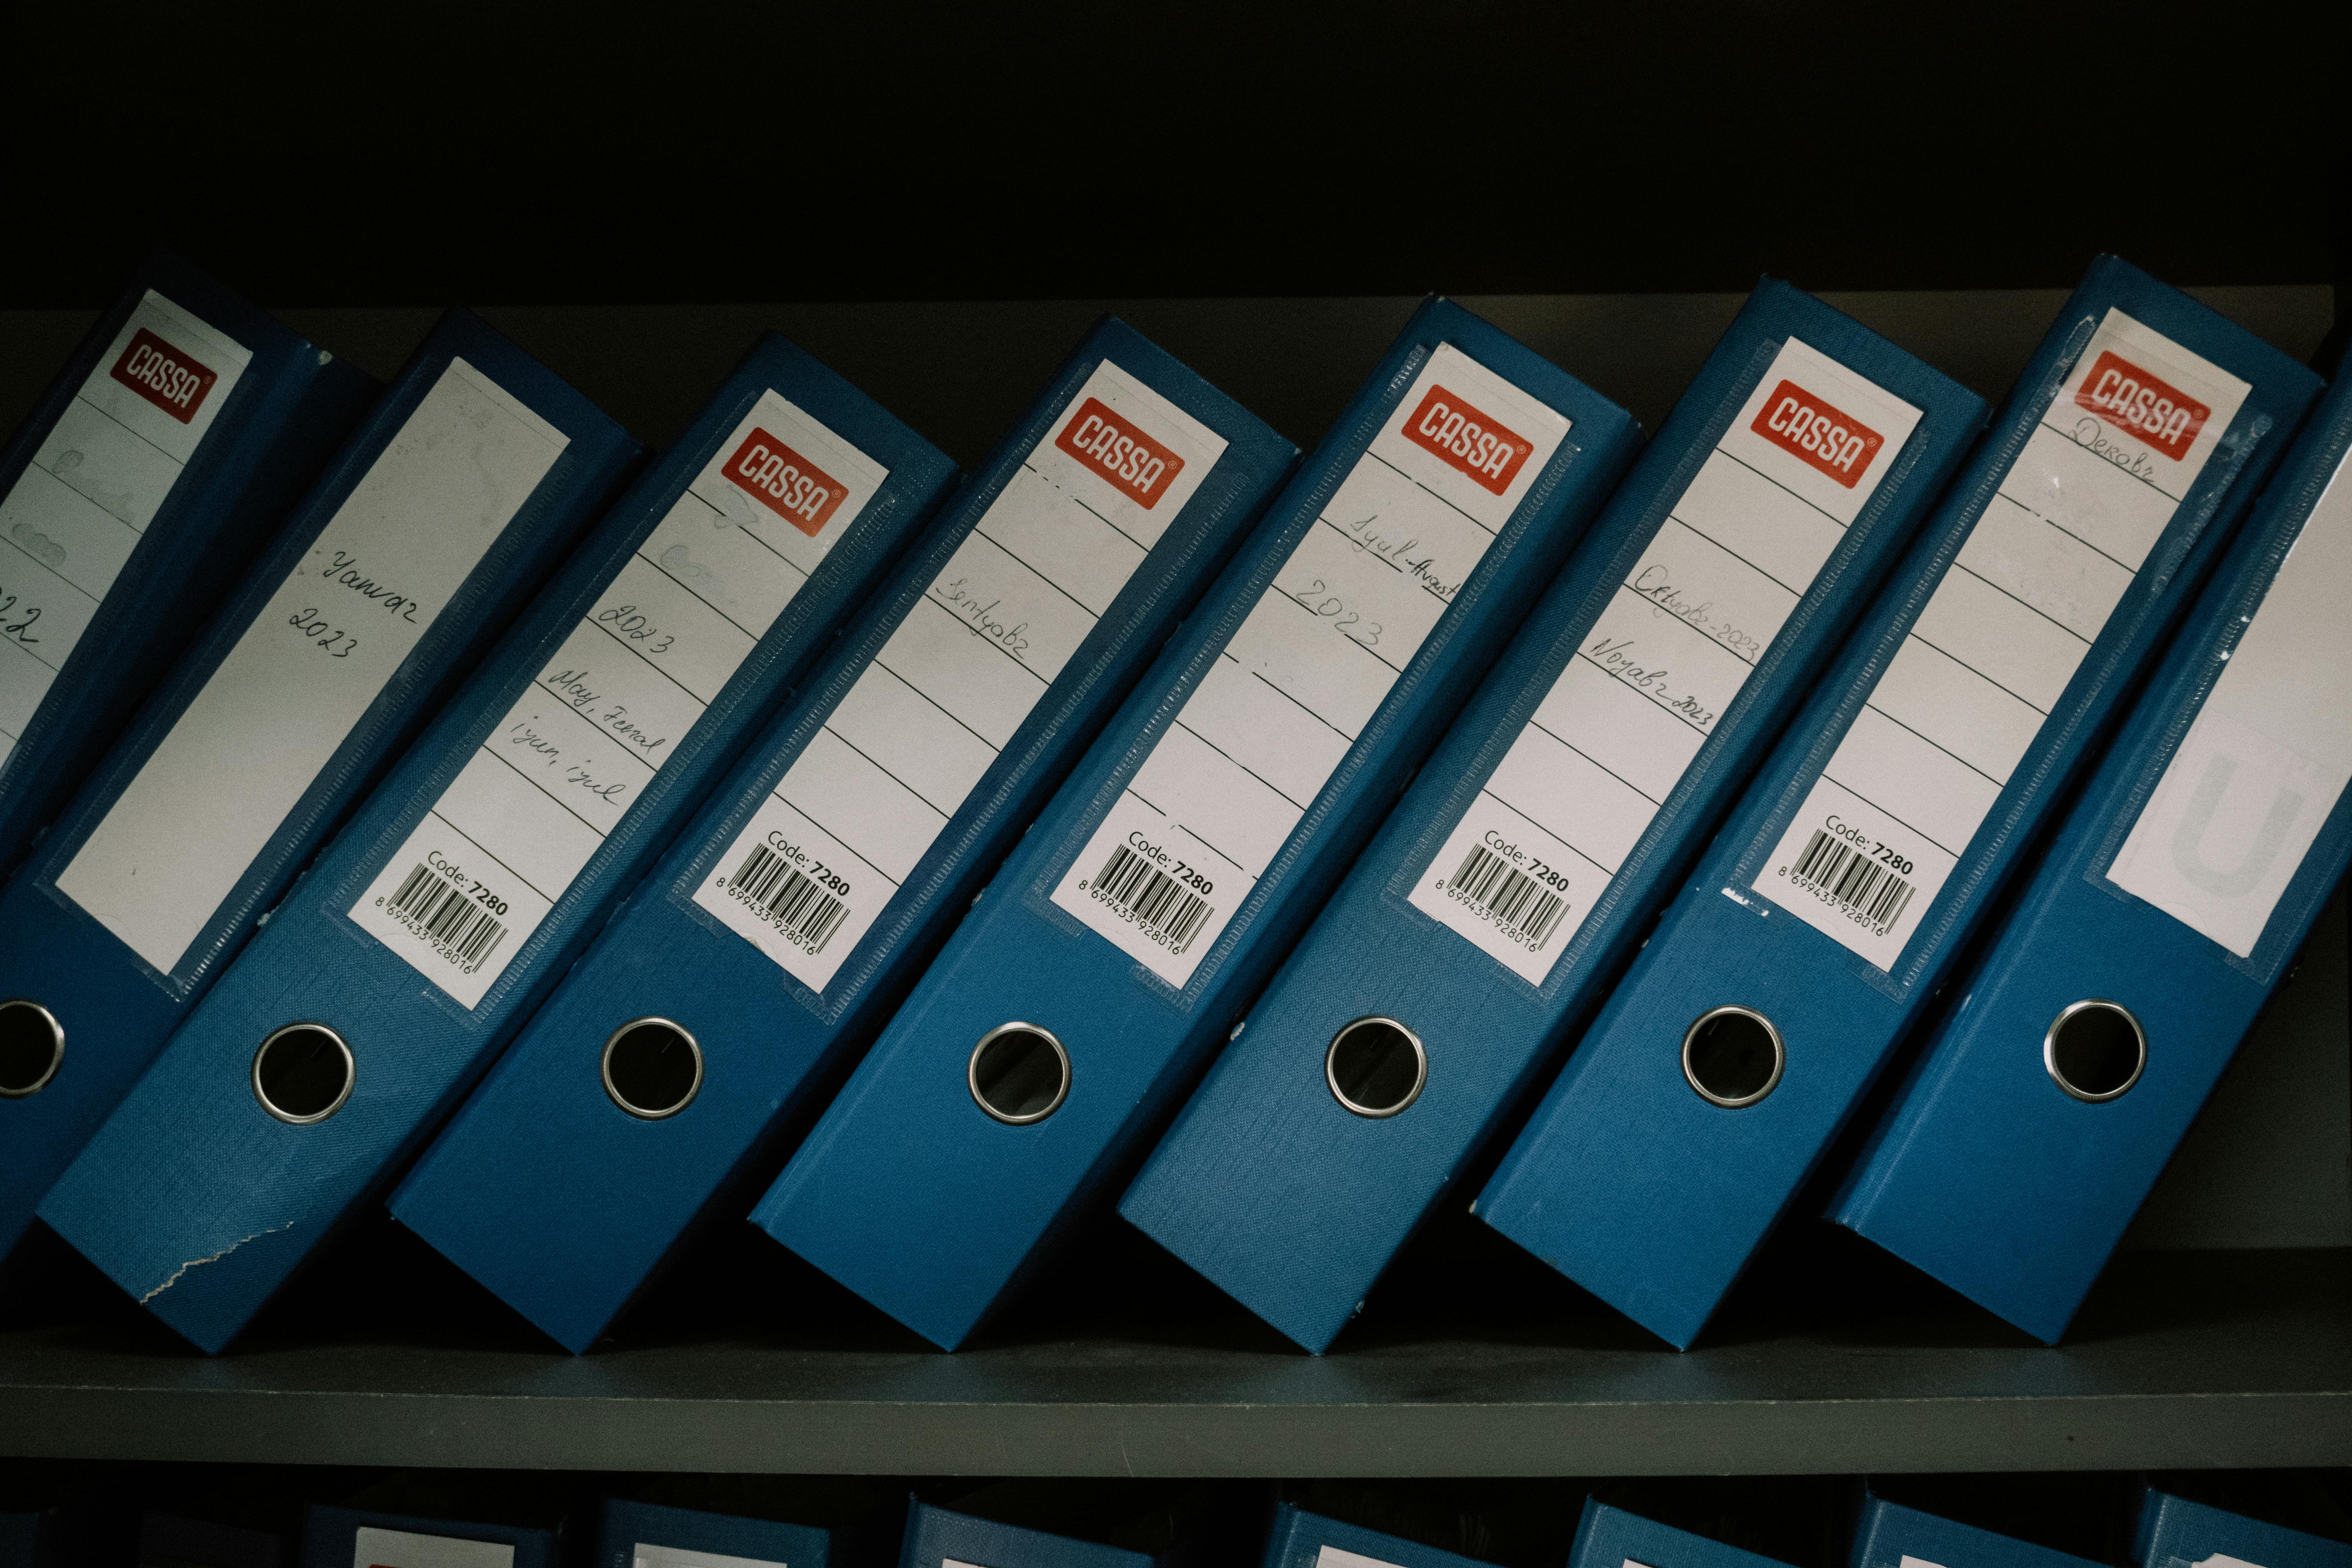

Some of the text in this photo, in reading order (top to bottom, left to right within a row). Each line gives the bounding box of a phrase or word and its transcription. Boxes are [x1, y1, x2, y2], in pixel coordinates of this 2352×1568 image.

[126, 344, 201, 408] CASSA
[2092, 368, 2191, 445] CASSA
[1072, 414, 1165, 494] CASSA
[1419, 402, 1514, 479] CASSA
[1768, 397, 1865, 473] CASSA
[739, 444, 829, 521] CASSA
[289, 608, 357, 657] 2023
[598, 605, 674, 653] 2023
[1295, 579, 1383, 646] 2023
[768, 831, 850, 896] Code: 7280
[1129, 831, 1213, 895] Code: 7280
[1485, 830, 1569, 892] Code: 7280
[1826, 815, 1913, 875] Code: 7280
[428, 851, 508, 916] Code: 7280
